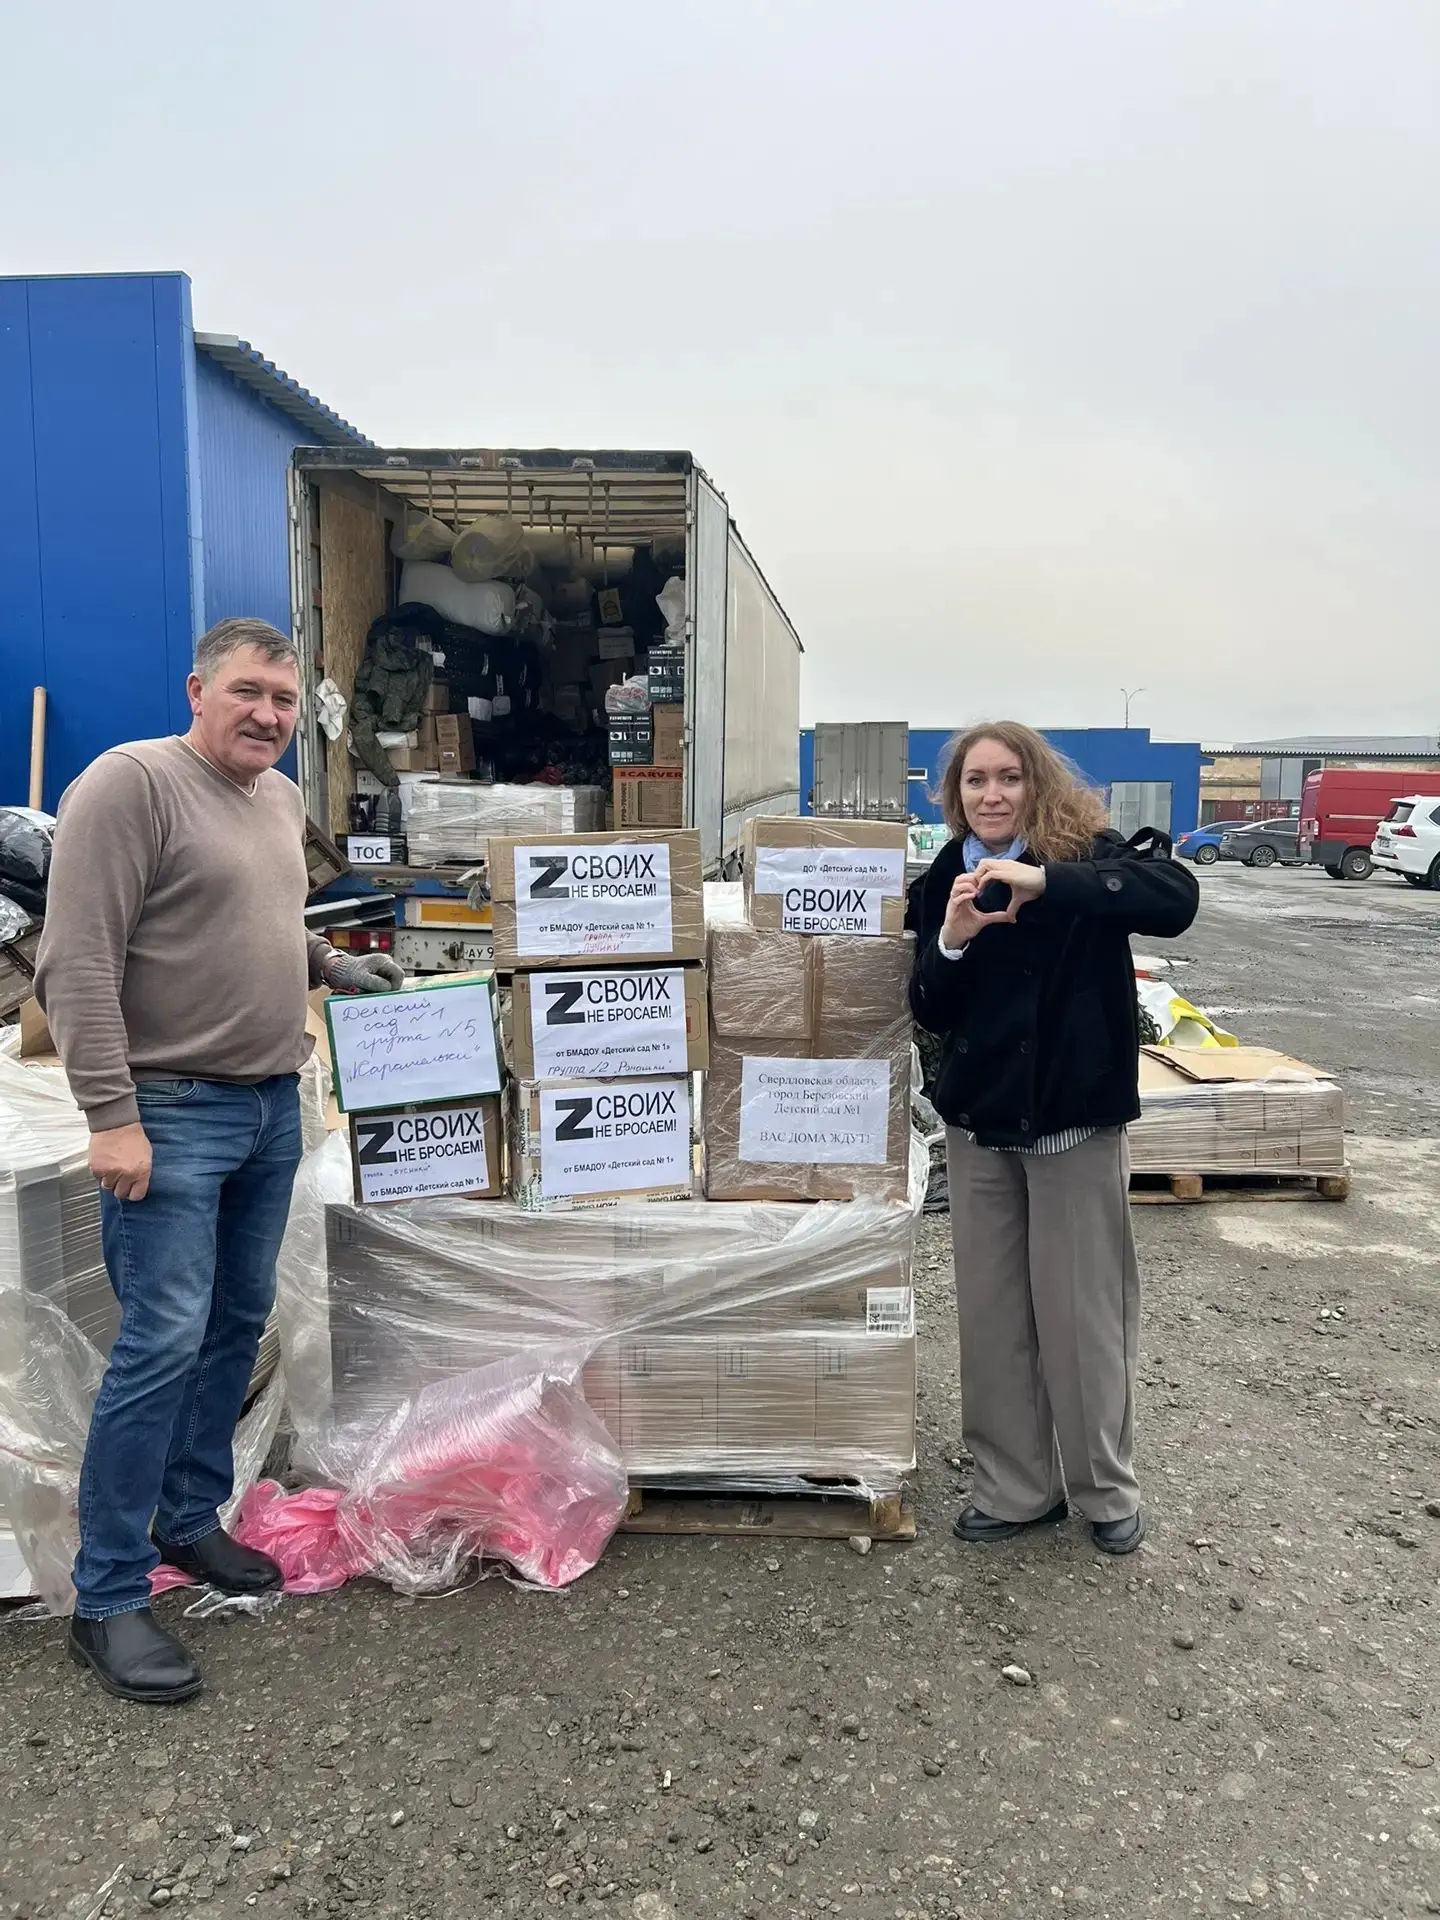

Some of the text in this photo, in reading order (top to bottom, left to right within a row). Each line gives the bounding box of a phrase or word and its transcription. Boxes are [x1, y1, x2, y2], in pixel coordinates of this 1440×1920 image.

[354, 847, 384, 859] ТОС
[572, 854, 656, 880] СВОИХ
[820, 864, 853, 873] «Детский
[854, 866, 867, 874] сад
[530, 856, 570, 898] Z
[572, 883, 657, 898] НЕ БРОСАЕМ!
[786, 888, 867, 913] СВОИХ
[550, 923, 583, 932] БМАДОУ
[585, 922, 619, 932] «Детский
[621, 923, 635, 931] сад
[636, 922, 645, 930] №
[784, 917, 867, 931] НЕ БРОСАЕМ!
[587, 976, 670, 1004] СВОИХ
[545, 981, 585, 1025] Z
[587, 1005, 672, 1024] НЕ БРОСАЕМ!
[556, 1050, 564, 1058] от
[566, 1048, 600, 1057] БМАДОУ
[601, 1046, 635, 1056] «Детский
[637, 1045, 650, 1053] сад
[651, 1043, 661, 1051] №
[596, 1090, 676, 1119] СВОИХ
[774, 1103, 819, 1115] Детский
[397, 1111, 482, 1143] СВОИХ
[555, 1098, 594, 1141] Z
[595, 1119, 677, 1138] НЕ БРОСАЕМ!
[357, 1121, 397, 1165] Z
[760, 1132, 870, 1144] ВАС ДОМА ЖДУТ!
[399, 1139, 484, 1162] НЕ БРОСАЕМ!
[574, 1163, 606, 1173] БМАДОУ
[608, 1160, 641, 1169] «Детский
[642, 1159, 655, 1167] сад
[380, 1185, 413, 1196] БМАДОУ
[415, 1182, 449, 1192] «Детский
[450, 1181, 464, 1189] сад
[465, 1178, 474, 1186] №
